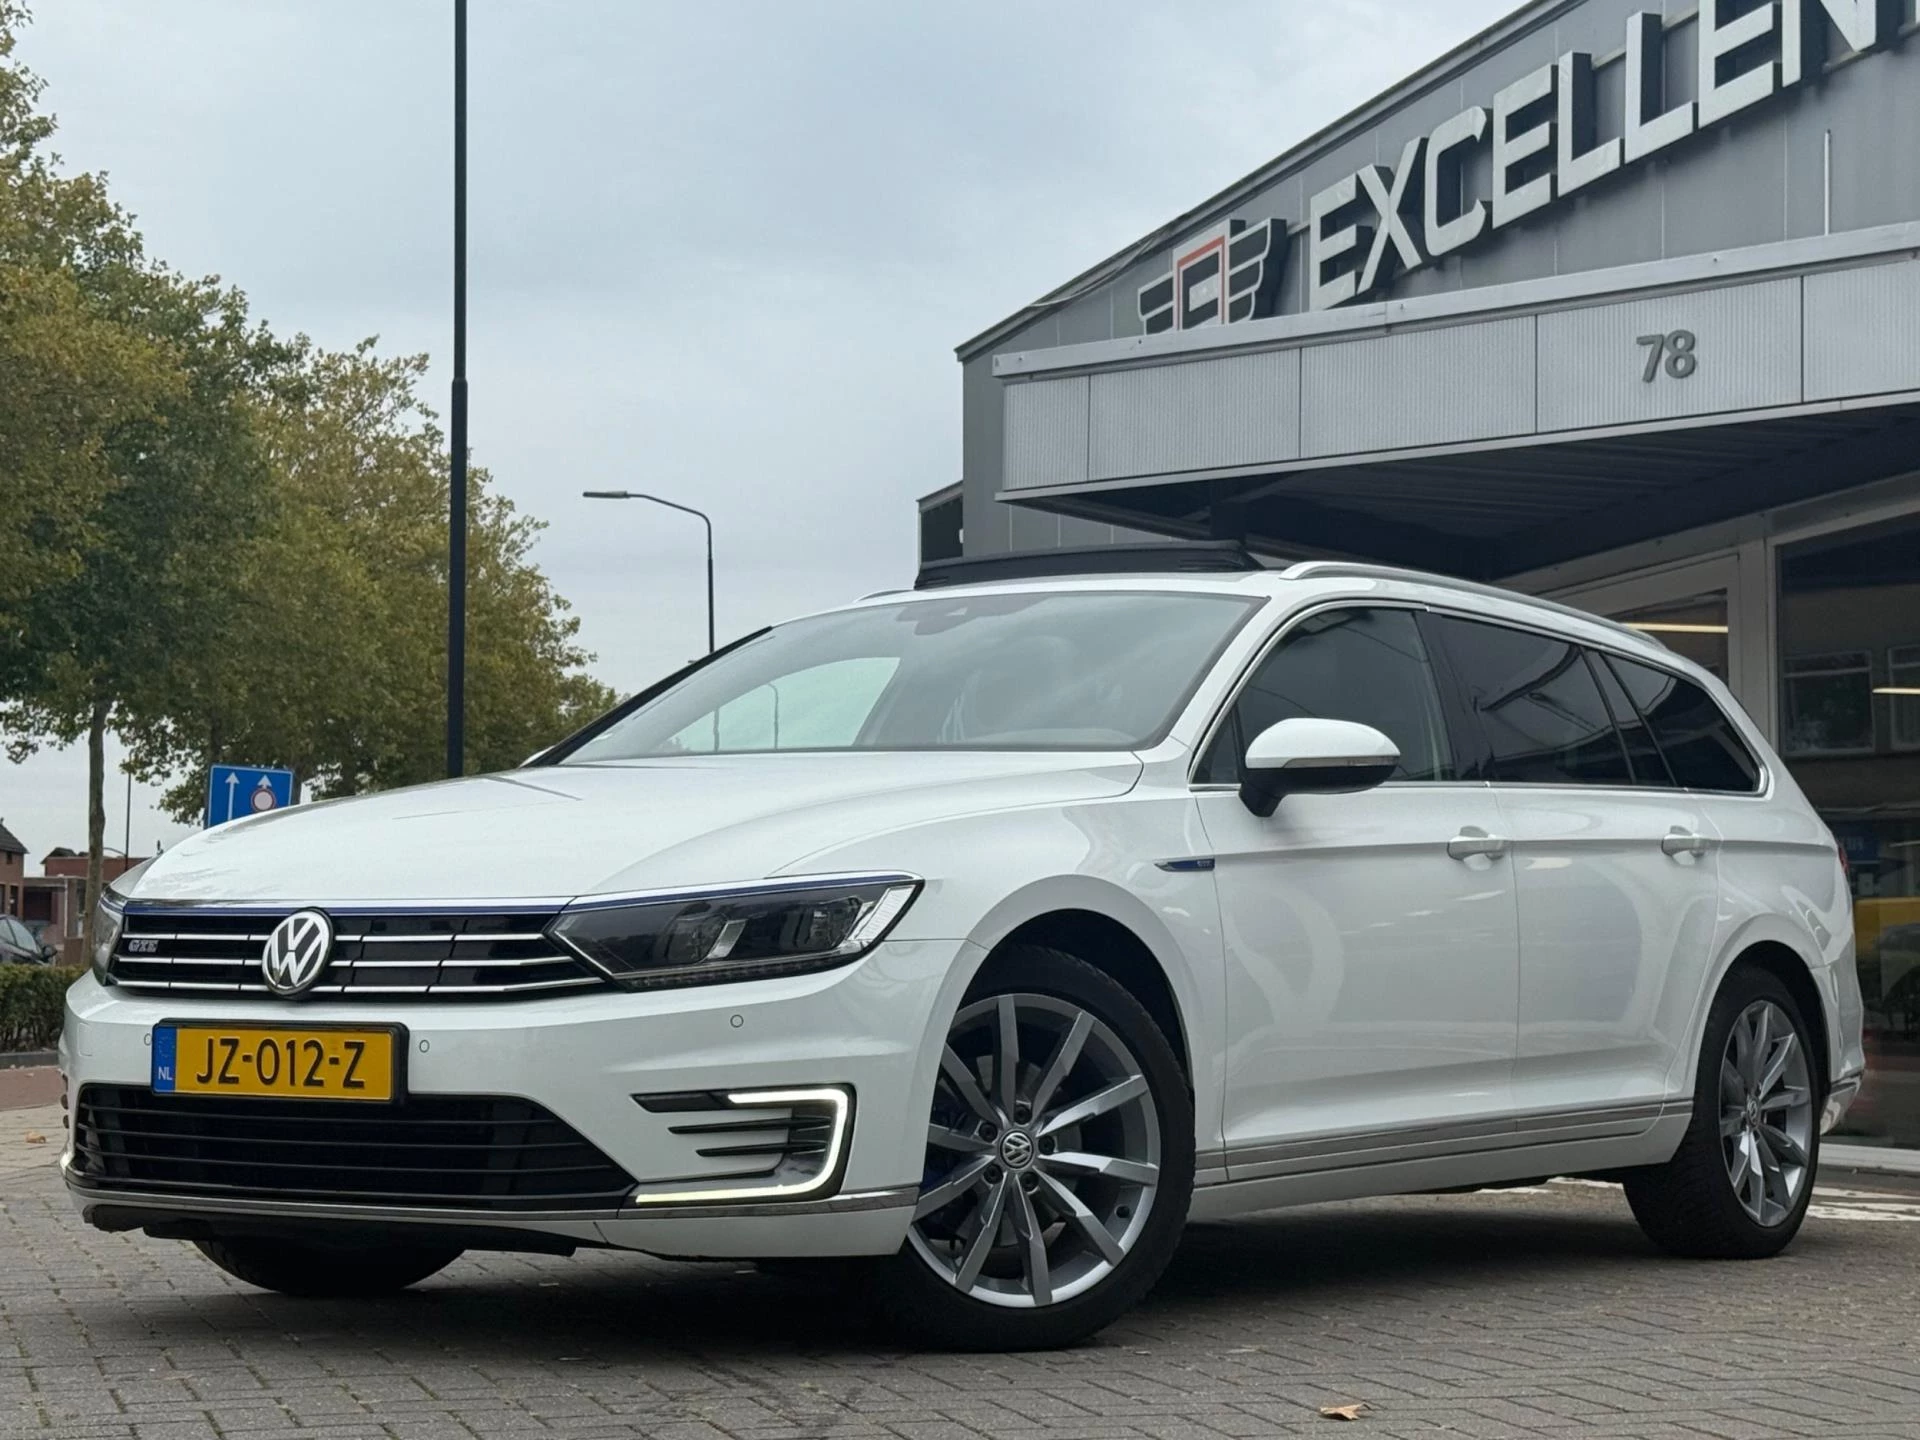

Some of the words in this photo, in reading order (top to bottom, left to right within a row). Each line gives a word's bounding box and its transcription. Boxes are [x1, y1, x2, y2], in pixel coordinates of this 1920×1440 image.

[1309, 0, 1920, 311] EXCELLEN
[1636, 329, 1696, 383] 78
[158, 1066, 173, 1081] NL
[196, 1037, 366, 1089] JZ-012-Z
